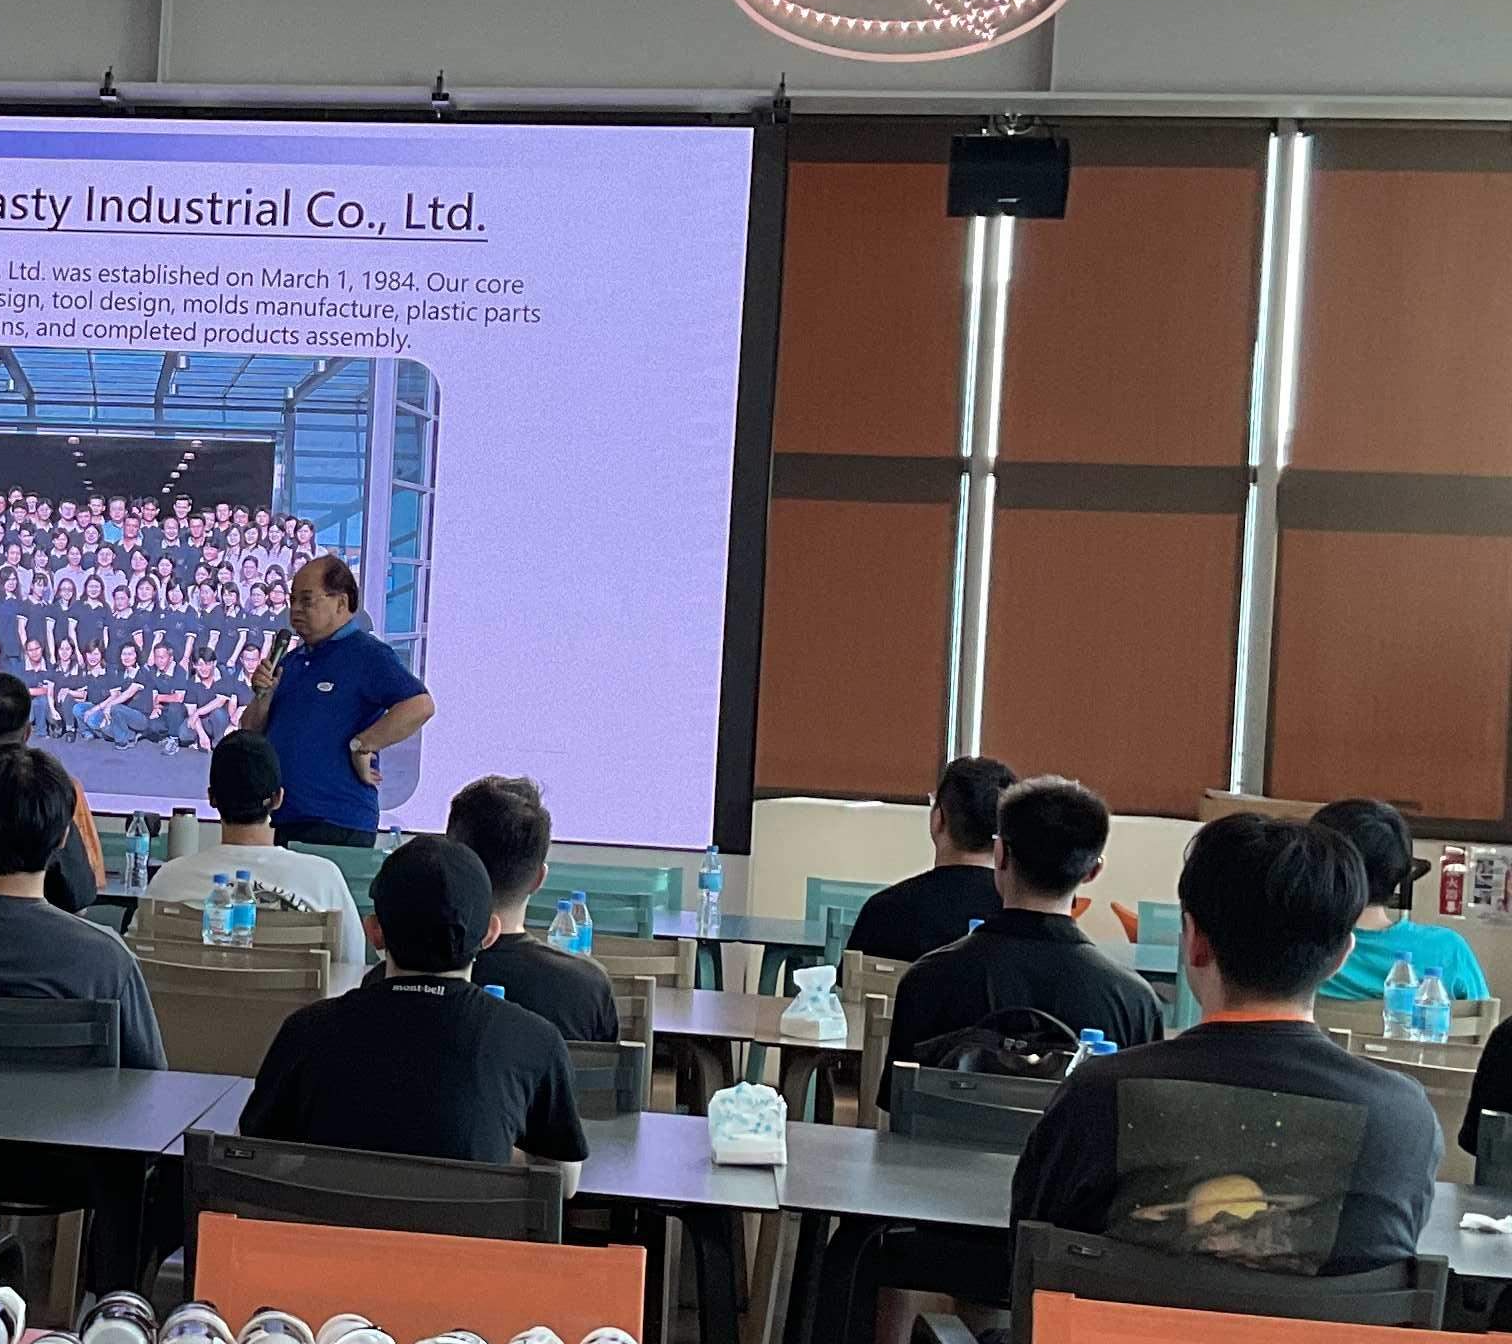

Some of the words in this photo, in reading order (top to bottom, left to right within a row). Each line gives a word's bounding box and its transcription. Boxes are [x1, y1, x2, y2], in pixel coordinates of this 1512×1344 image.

[86, 185, 291, 226] Industrial
[306, 191, 386, 234] Co.,
[405, 192, 486, 231] Ltd.
[9, 262, 46, 281] Ltd.
[52, 267, 91, 282] was
[99, 263, 219, 285] established
[226, 272, 253, 287] on
[261, 268, 328, 289] March
[338, 270, 353, 292] 1,
[363, 271, 419, 291] 1984.
[427, 273, 468, 293] Our
[475, 277, 524, 295] core
[52, 290, 93, 310] tool
[100, 291, 176, 316] design,
[183, 294, 248, 314] molds
[256, 295, 398, 321] manufacture,
[407, 299, 477, 324] plastic
[485, 303, 541, 326] parts
[37, 319, 74, 338] and
[83, 320, 195, 344] completed
[204, 324, 298, 346] products
[306, 327, 412, 353] assembly.
